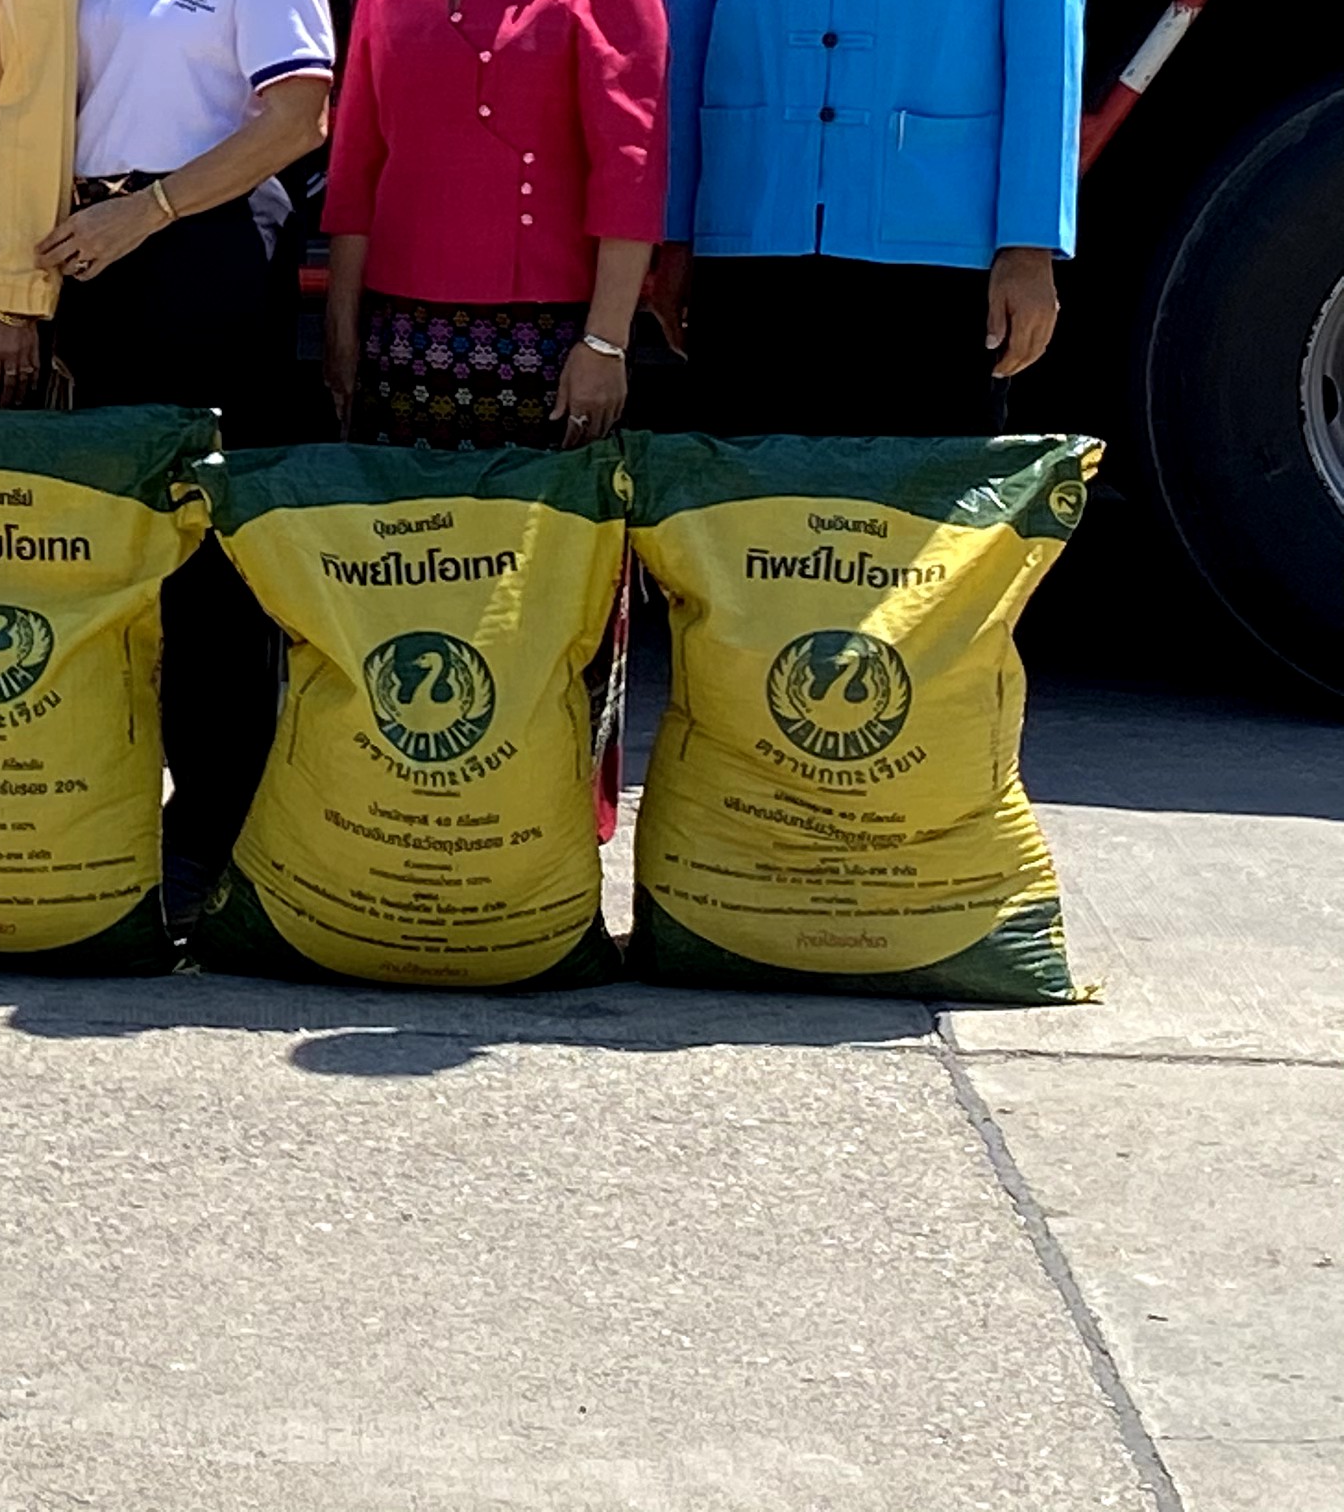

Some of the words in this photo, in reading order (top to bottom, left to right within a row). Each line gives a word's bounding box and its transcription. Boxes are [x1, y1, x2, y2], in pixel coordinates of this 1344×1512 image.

[320, 548, 520, 587] ทิพย์ไบโอเทค
[745, 545, 947, 589] ทิพย์ไบโอเทค
[353, 730, 519, 787] ตรานกกะเรียน
[754, 736, 928, 786] ตรานกกะเรียน
[54, 776, 90, 793] 20%
